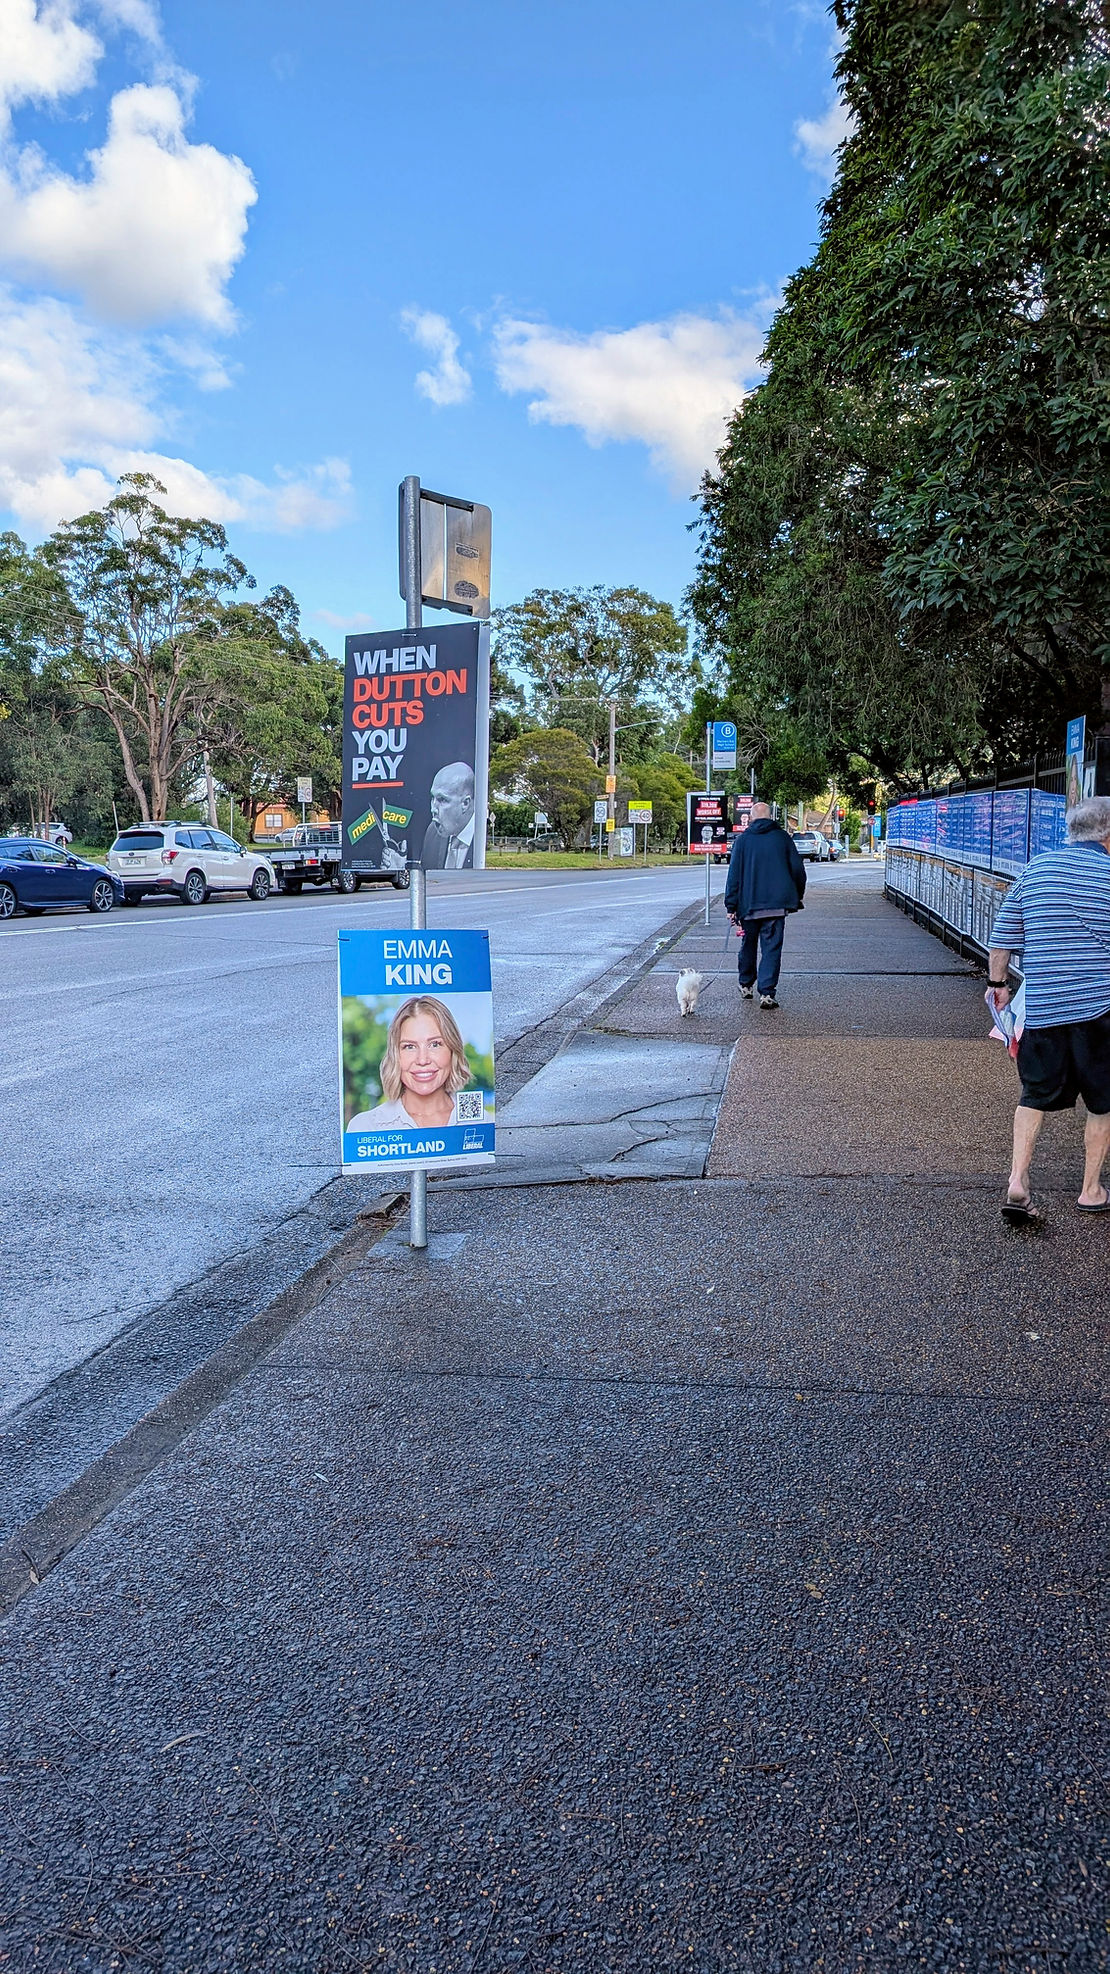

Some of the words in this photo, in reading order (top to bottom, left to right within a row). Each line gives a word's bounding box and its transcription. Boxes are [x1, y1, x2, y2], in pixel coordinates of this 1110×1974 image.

[353, 644, 437, 676] WHEN
[353, 668, 467, 703] DUTTON
[352, 700, 424, 729] CUTS
[352, 727, 407, 755] YOU
[352, 754, 404, 782] PAY
[383, 939, 453, 960] EMMA
[385, 963, 453, 986] KING
[357, 1135, 386, 1144] LIBERAL
[388, 1134, 403, 1142] FOR
[357, 1140, 445, 1158] SHORTLAND
